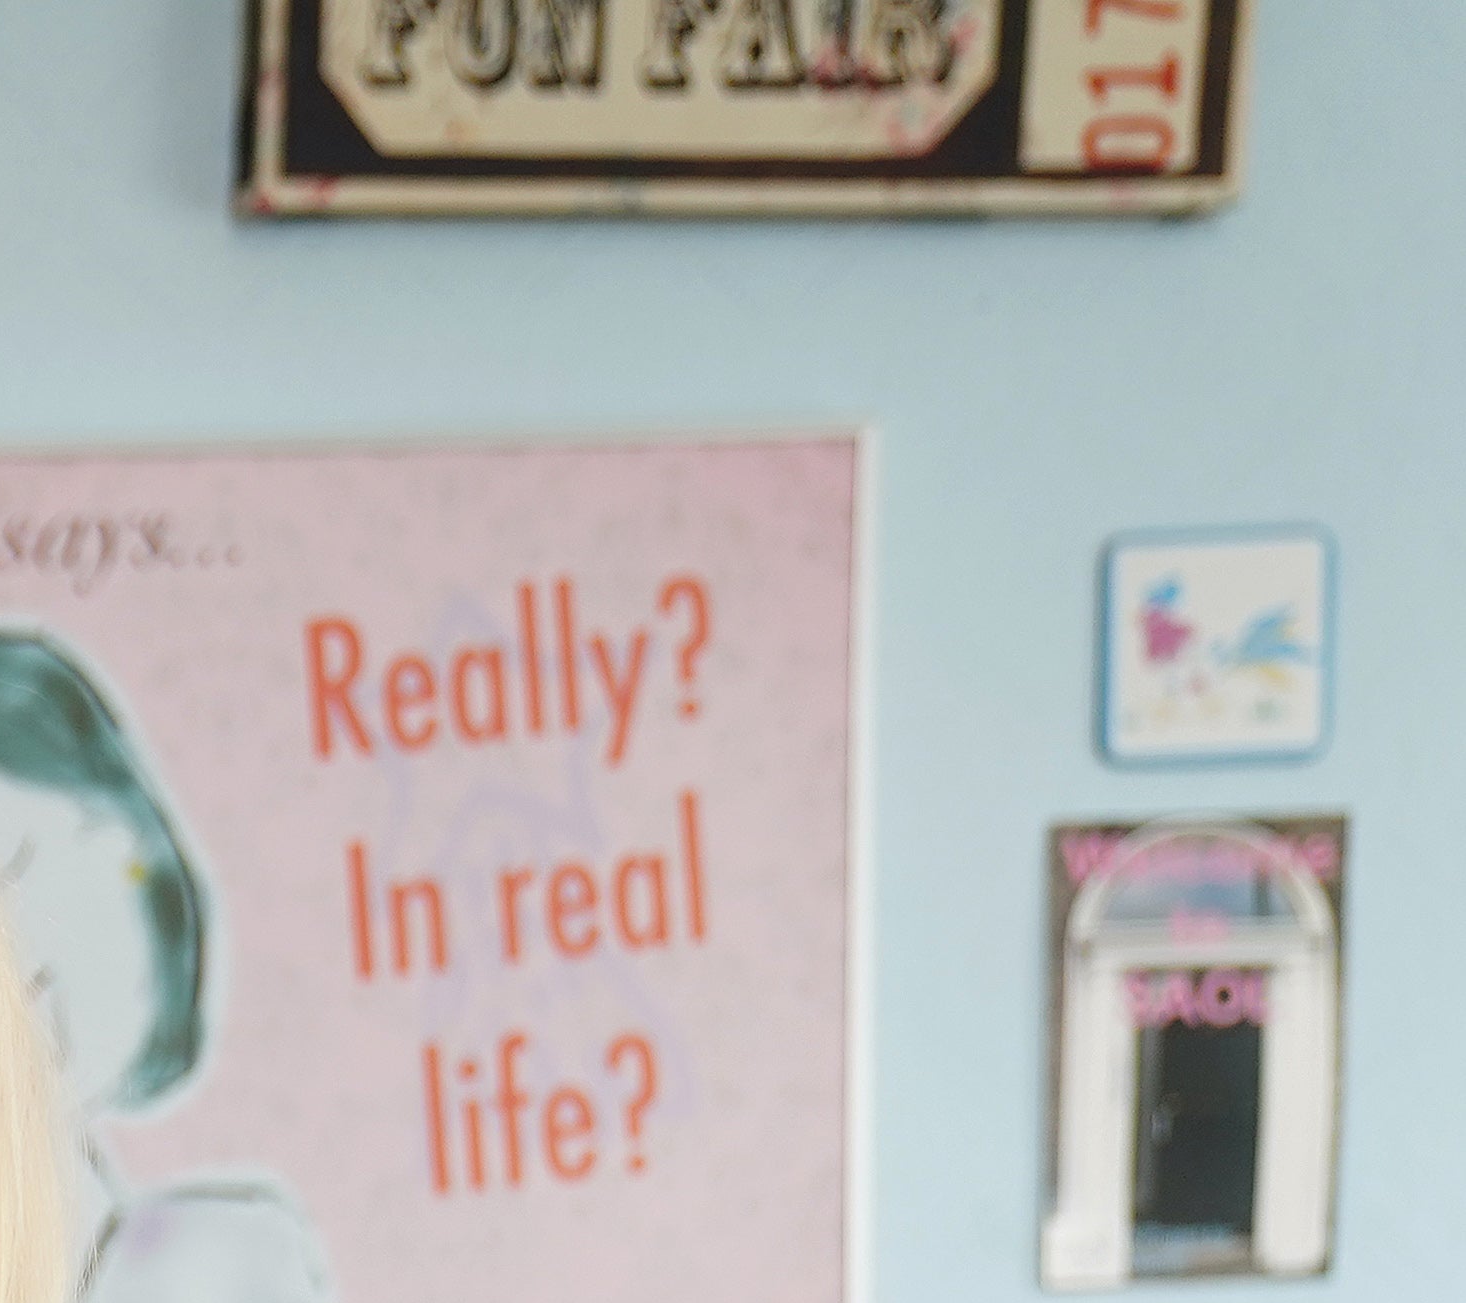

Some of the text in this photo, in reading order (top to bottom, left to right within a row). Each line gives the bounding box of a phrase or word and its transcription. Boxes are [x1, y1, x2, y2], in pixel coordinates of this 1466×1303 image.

[300, 575, 715, 771] Really?
[346, 788, 708, 982] In real
[421, 1030, 661, 1197] life?
